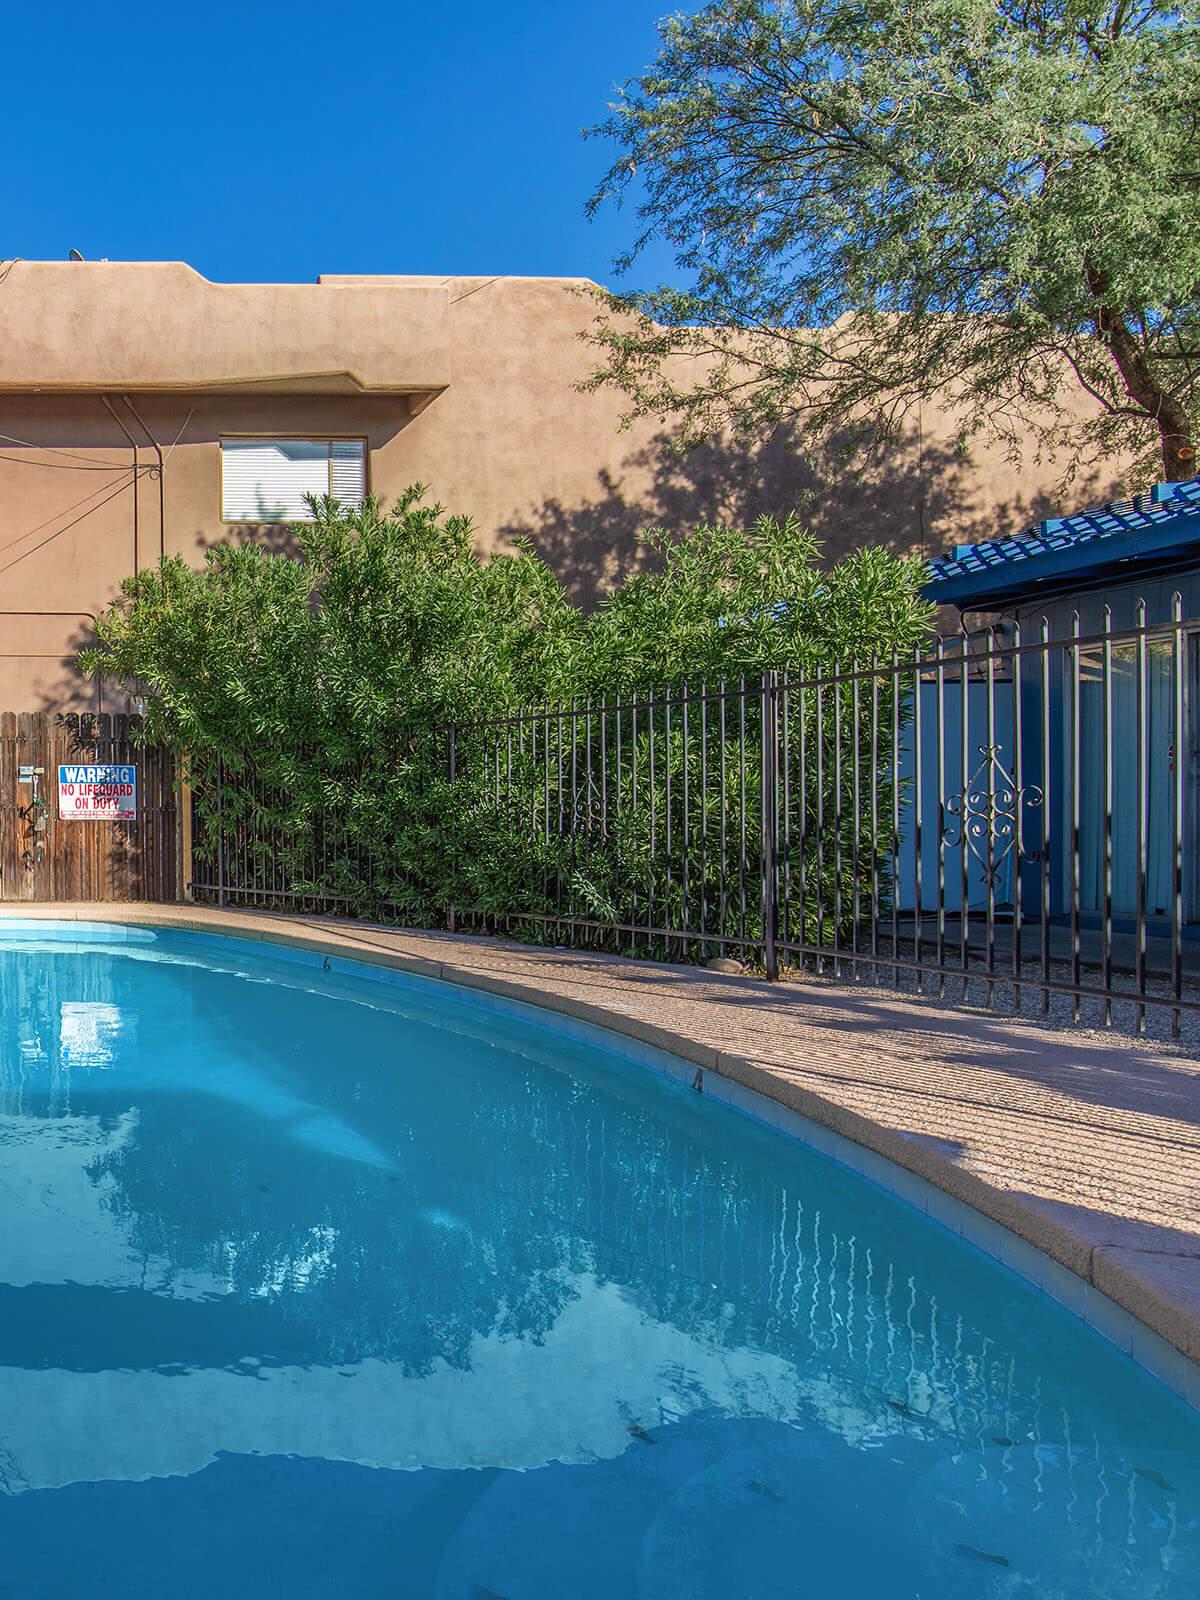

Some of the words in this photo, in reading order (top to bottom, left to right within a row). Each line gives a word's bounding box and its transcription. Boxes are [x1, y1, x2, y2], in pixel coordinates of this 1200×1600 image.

[65, 767, 130, 783] WARNING
[61, 784, 75, 796] NO
[80, 784, 133, 796] LIFEGUARD
[75, 798, 89, 810] ON
[93, 797, 119, 810] DUTY
